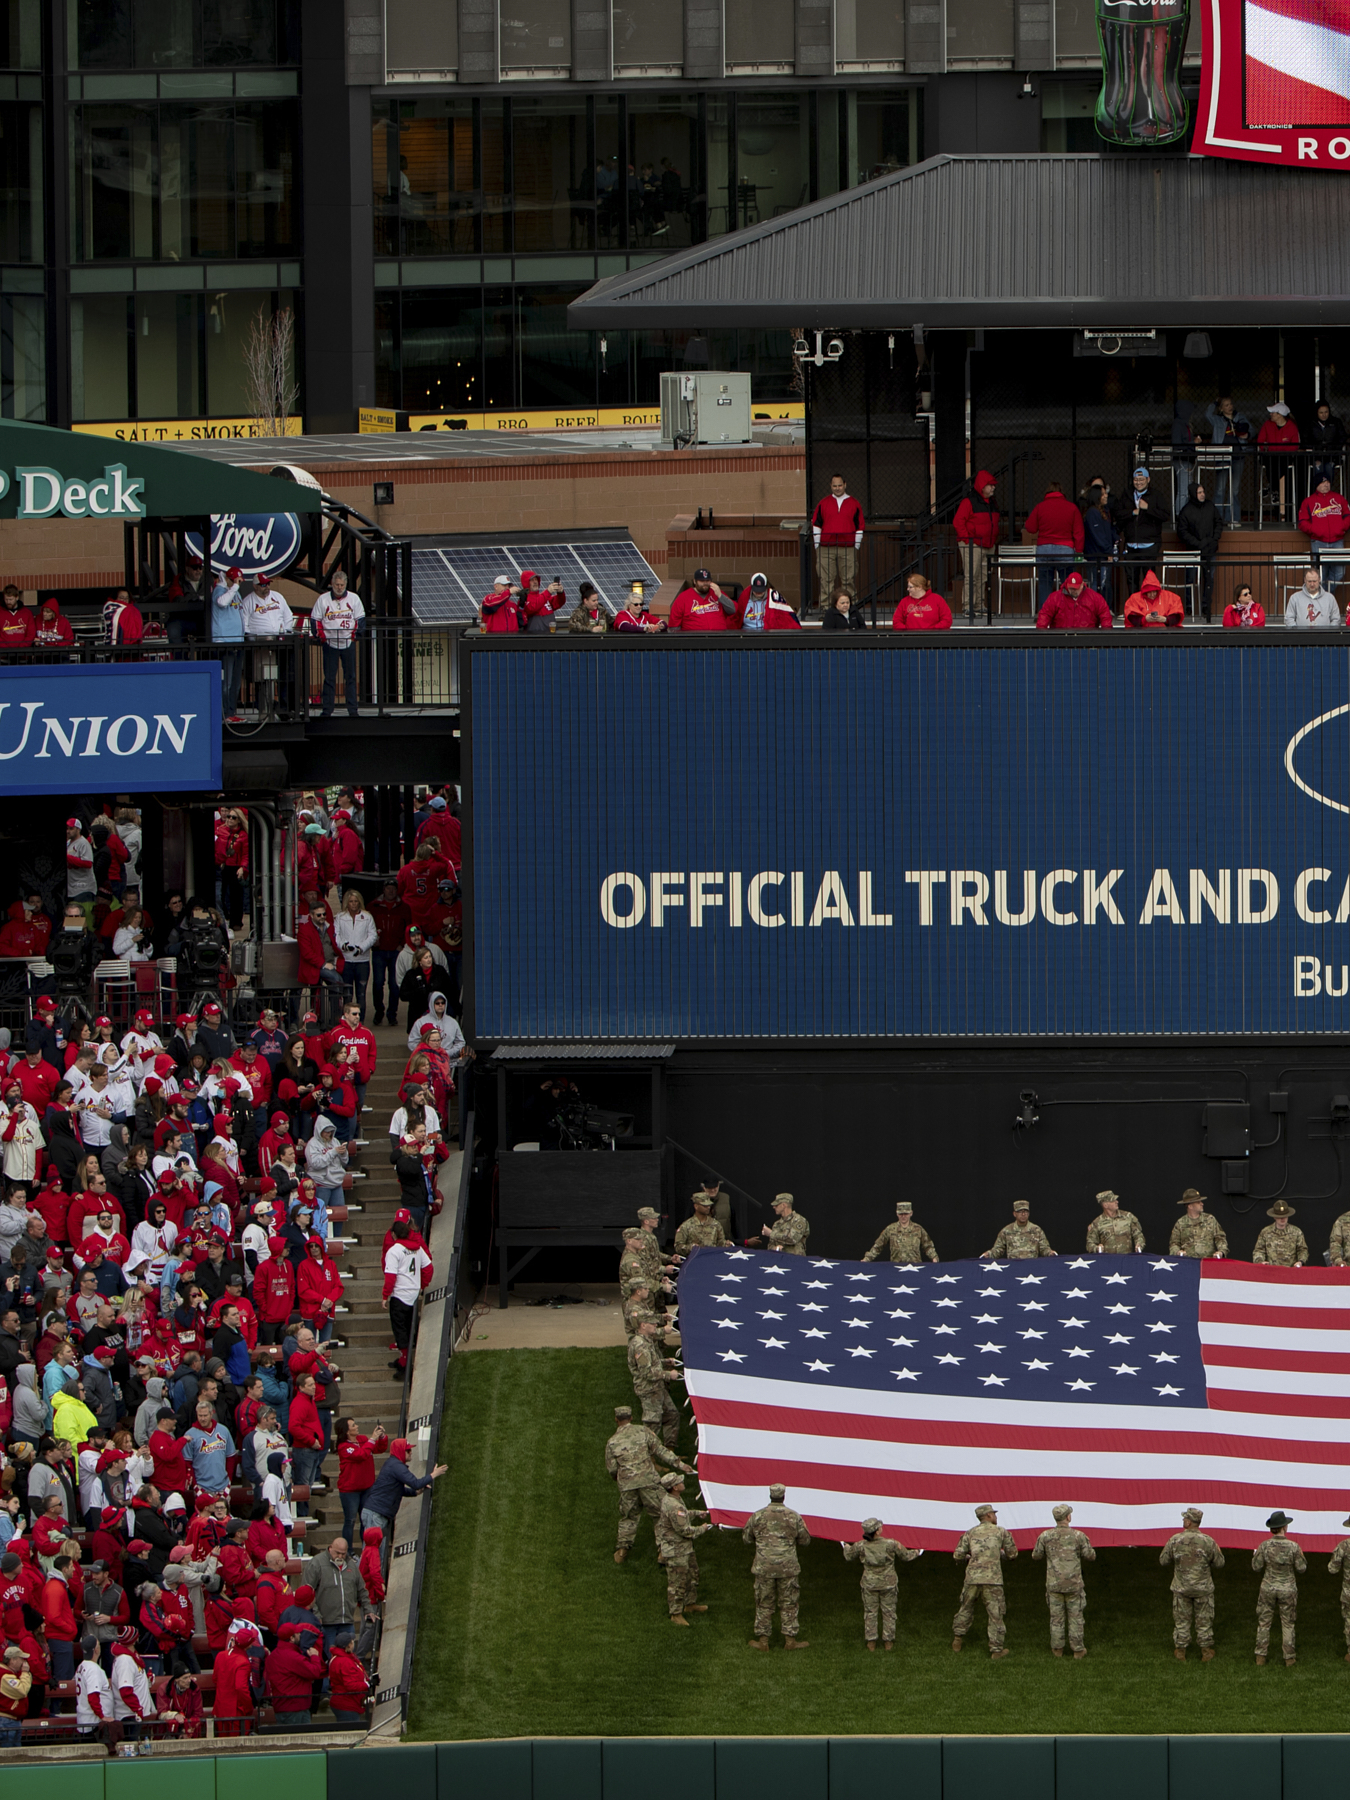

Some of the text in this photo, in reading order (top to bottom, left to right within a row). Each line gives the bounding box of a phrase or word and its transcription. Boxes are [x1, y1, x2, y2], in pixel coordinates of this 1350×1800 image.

[115, 428, 168, 442] SALT
[190, 424, 262, 441] SMOKE
[21, 470, 141, 514] Deck
[210, 514, 275, 560] Ford
[327, 611, 352, 621] Cardinals
[340, 620, 350, 629] 45
[0, 702, 198, 760] UNION
[416, 877, 427, 895] 5
[600, 870, 893, 928] OFFICIAL
[904, 869, 1125, 926] TRUCK
[1139, 868, 1279, 925] AND
[338, 1034, 369, 1046] Cardinals
[409, 1257, 416, 1276] 4
[204, 1444, 226, 1454] Cardinals
